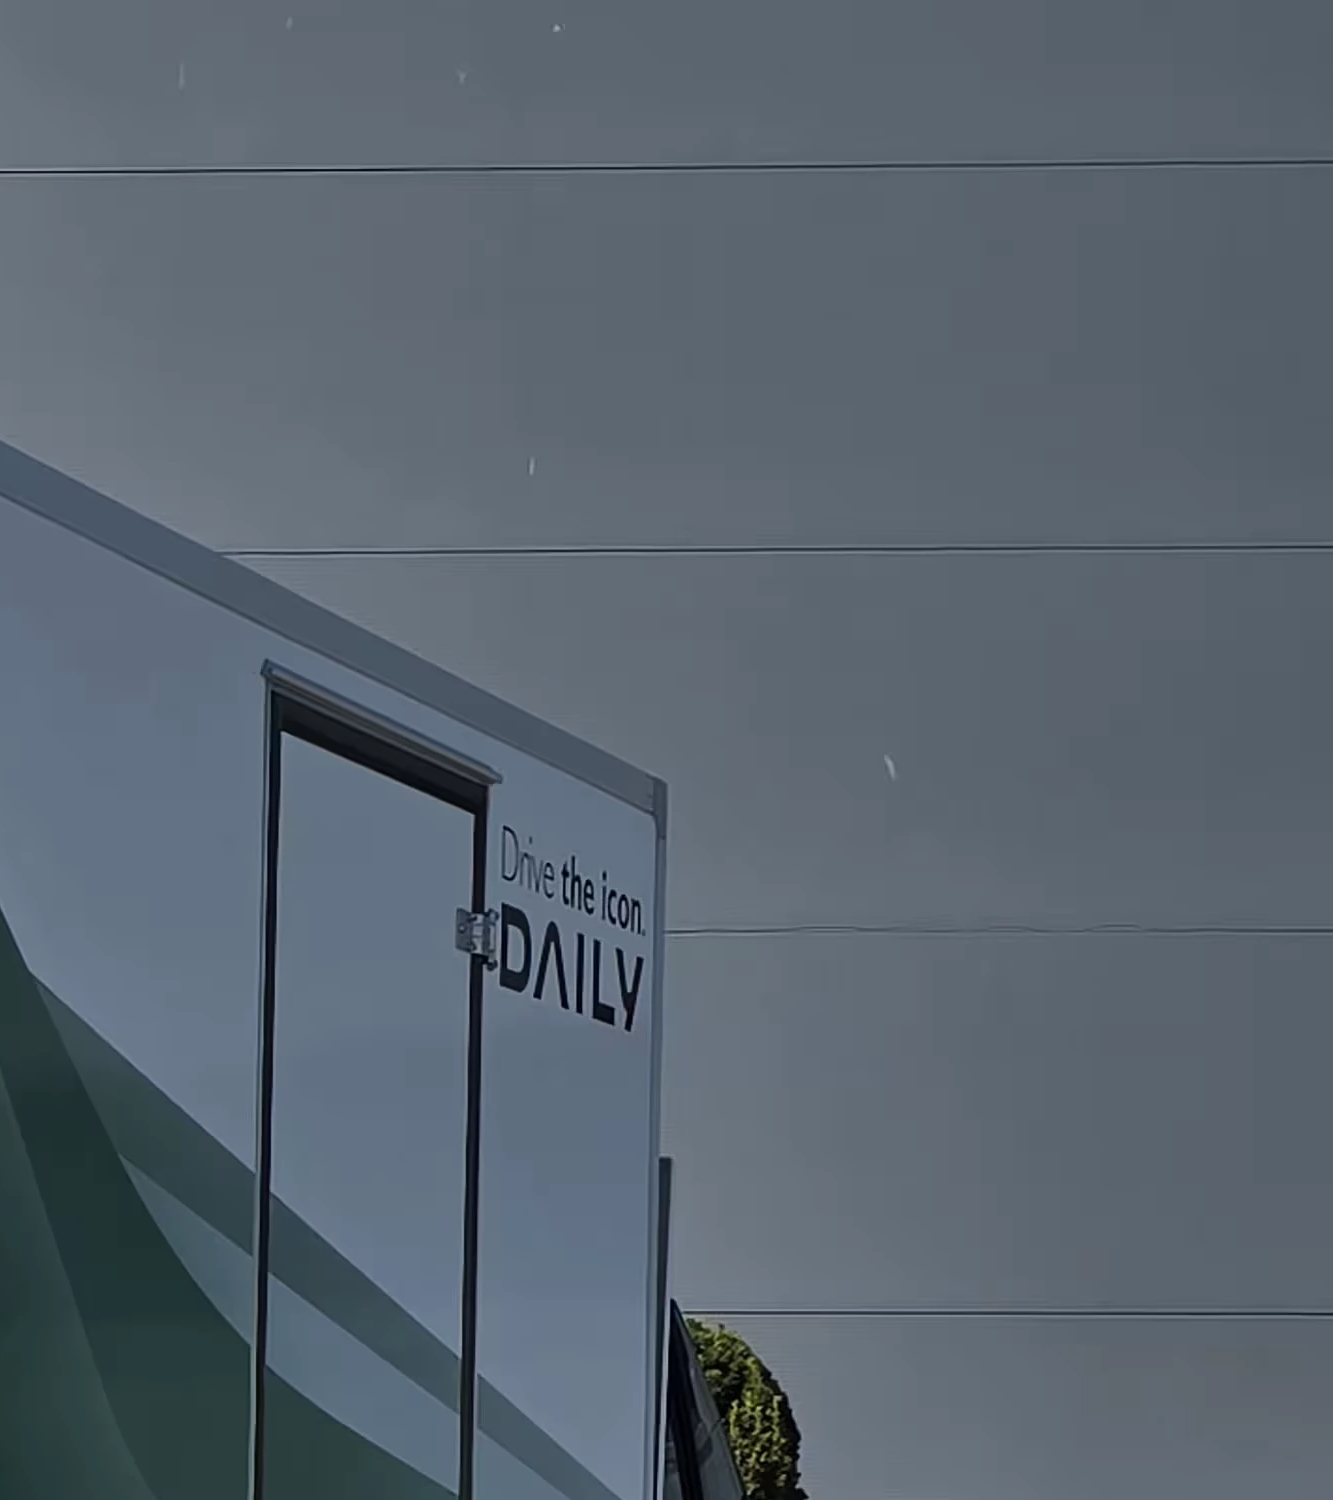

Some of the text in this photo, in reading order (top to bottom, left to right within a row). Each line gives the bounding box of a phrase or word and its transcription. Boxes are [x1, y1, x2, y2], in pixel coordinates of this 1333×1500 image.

[501, 825, 555, 899] Drive
[561, 855, 595, 915] the
[499, 902, 644, 1032] DAILY
